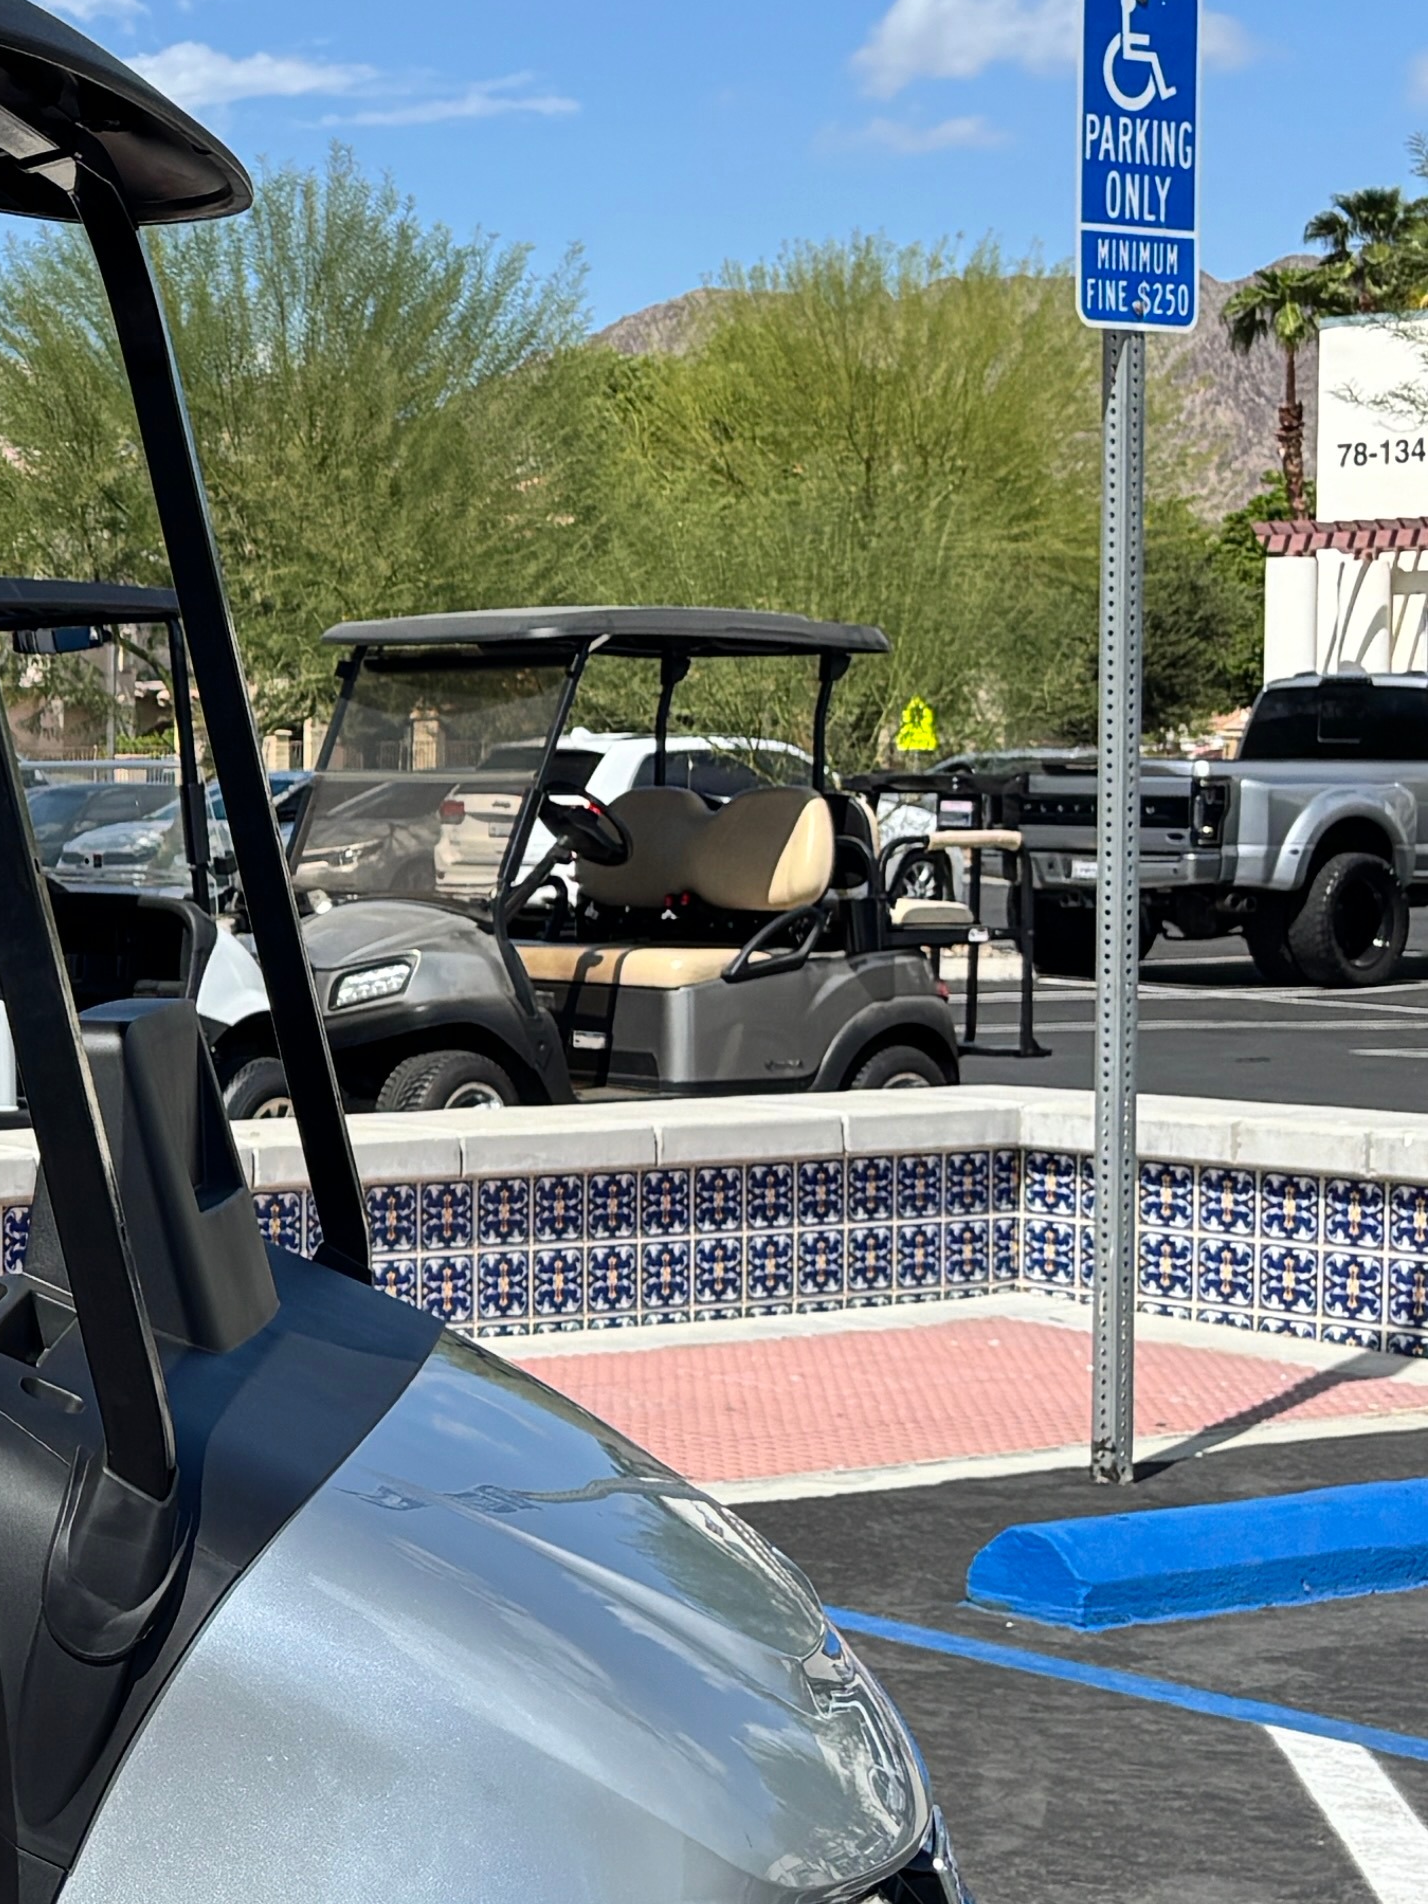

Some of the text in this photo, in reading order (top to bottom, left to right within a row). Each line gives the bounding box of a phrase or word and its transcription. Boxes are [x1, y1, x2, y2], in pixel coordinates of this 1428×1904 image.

[1085, 113, 1193, 170] PARKING
[1105, 170, 1172, 223] ONLY
[1097, 237, 1179, 275] MINIMUM
[1086, 278, 1189, 317] FINE $250
[1336, 437, 1427, 468] 78-134
